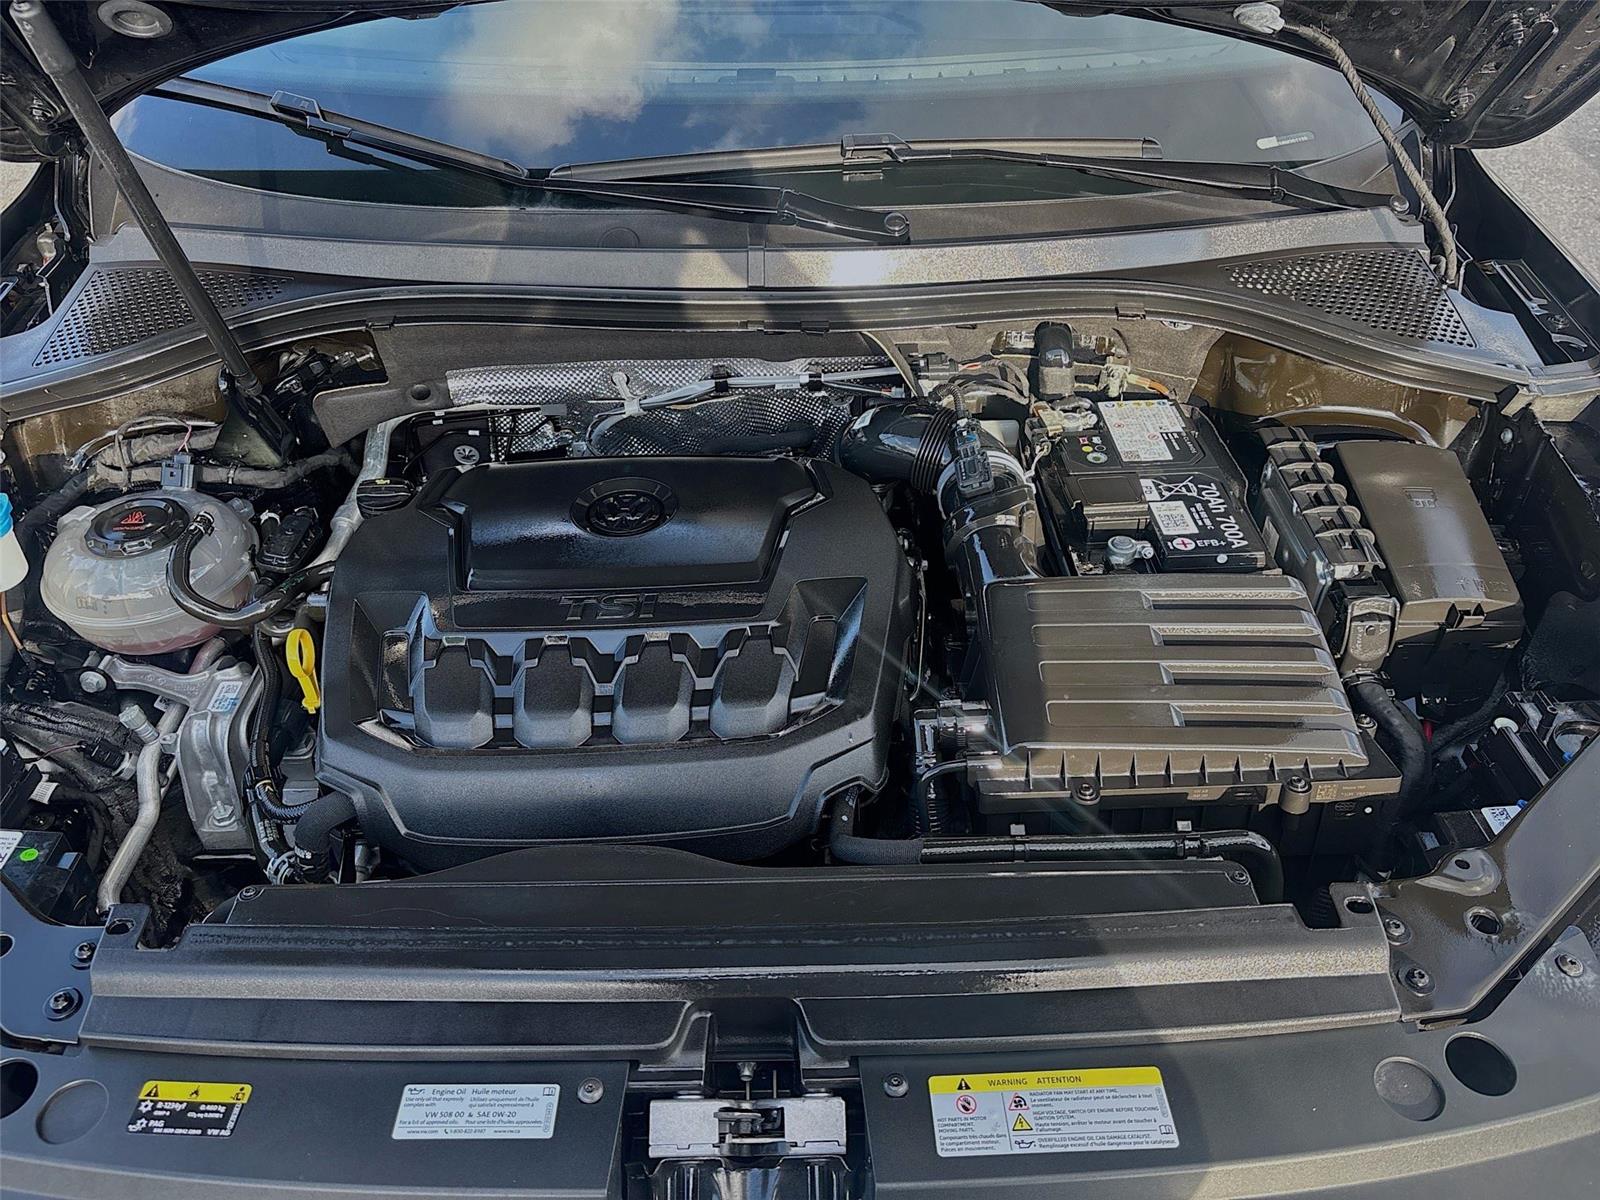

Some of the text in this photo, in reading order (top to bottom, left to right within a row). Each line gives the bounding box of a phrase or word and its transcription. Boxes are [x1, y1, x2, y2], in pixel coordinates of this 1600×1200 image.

[1197, 482, 1228, 513] 70Ah
[1215, 515, 1249, 549] 700A
[1195, 538, 1227, 547] EFB+
[560, 592, 659, 621] TSI
[987, 1075, 1082, 1087] WARNING ATTENTION
[431, 1087, 467, 1097] Engine Oil
[471, 1087, 490, 1095] Huile
[147, 1119, 166, 1128] PAG
[207, 1128, 220, 1136] VW
